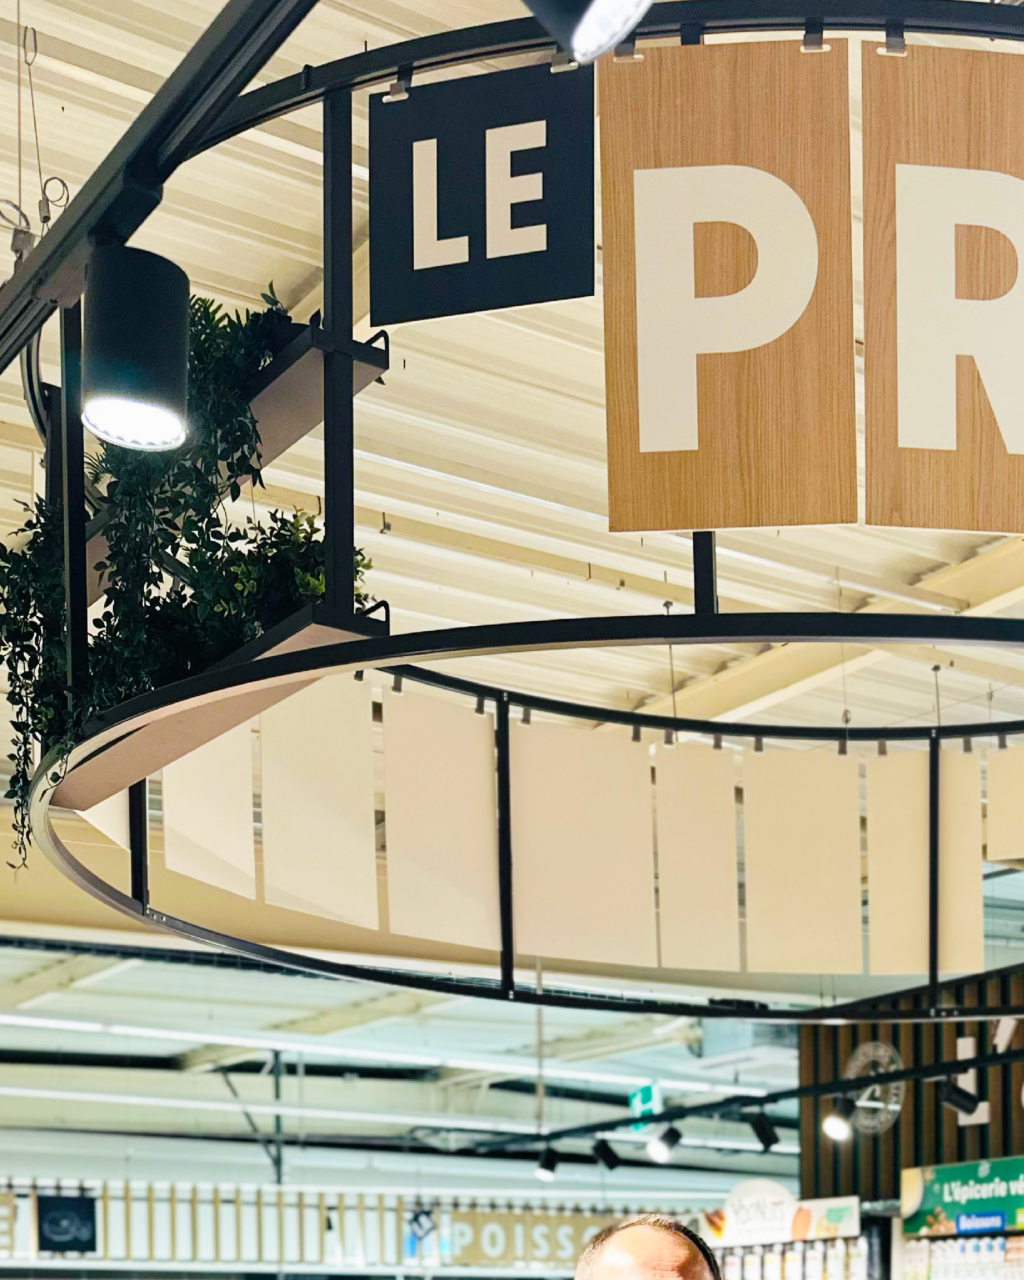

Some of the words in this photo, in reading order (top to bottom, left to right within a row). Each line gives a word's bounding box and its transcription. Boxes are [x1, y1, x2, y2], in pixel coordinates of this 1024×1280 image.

[412, 119, 548, 271] LE
[943, 1175, 1009, 1205] L'épicerie
[958, 1213, 1003, 1231] Boissons
